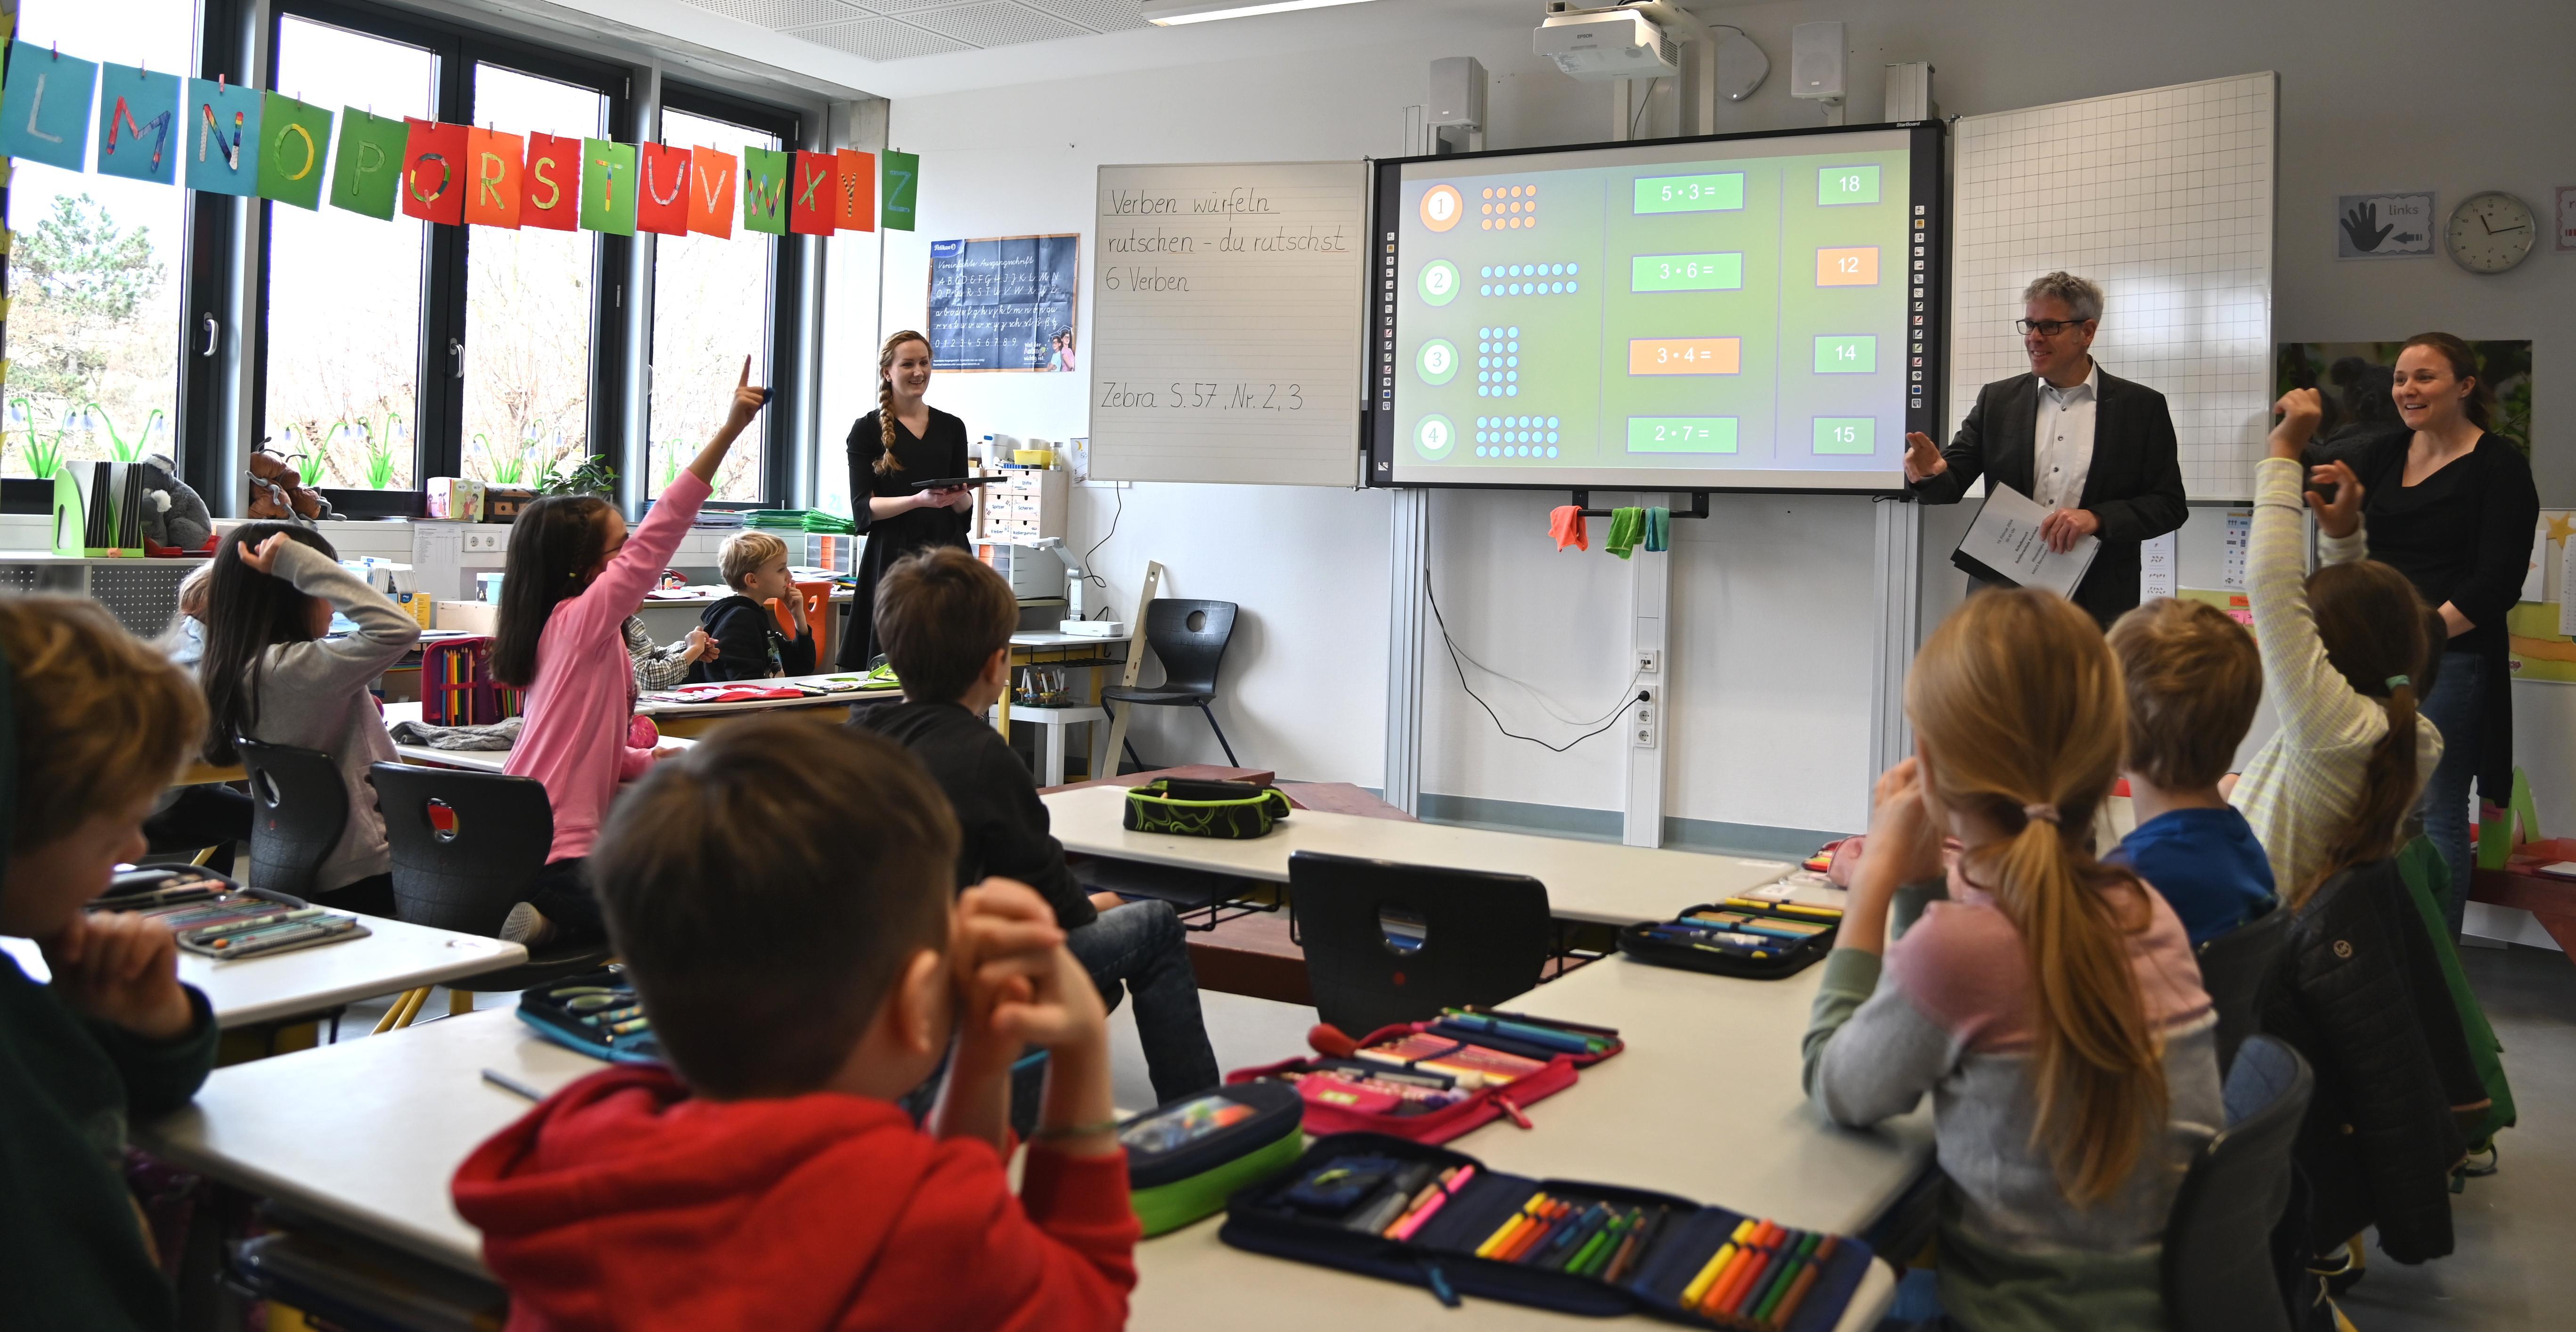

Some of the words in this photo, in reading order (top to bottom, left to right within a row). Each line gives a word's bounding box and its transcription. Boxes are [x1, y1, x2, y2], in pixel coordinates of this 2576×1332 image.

[27, 74, 63, 144] L
[106, 95, 171, 171] M
[199, 104, 243, 170] N
[274, 123, 314, 180] O
[352, 140, 385, 196] P
[410, 152, 450, 208] Q
[480, 152, 505, 210] R
[532, 157, 560, 209] S
[595, 159, 623, 212] T
[648, 155, 686, 205] U
[699, 165, 726, 213] V
[746, 169, 784, 220] W
[797, 161, 826, 212] X
[841, 172, 856, 217] Y
[889, 170, 911, 213] Z
[1839, 175, 1860, 192] 18
[1661, 186, 1672, 201] 5
[1689, 184, 1699, 200] 3
[1112, 189, 1178, 215] Verben
[1194, 187, 1269, 221] würfeln
[1438, 198, 1443, 214] 1
[2389, 204, 2419, 215] links
[1108, 227, 1193, 253] rutschen
[1220, 227, 1243, 252] du
[1254, 225, 1345, 253] rutschst
[1660, 263, 1669, 279] 3
[1687, 262, 1697, 278] 6
[1838, 257, 1858, 273] 12
[1106, 267, 1120, 291] 6
[1129, 267, 1190, 292] Verben
[1434, 273, 1443, 288] 2
[1432, 351, 1442, 367] 3
[1657, 347, 1668, 363] 3
[1684, 347, 1695, 362] 4
[1835, 344, 1856, 360] 14
[1101, 381, 1157, 408] Zebra
[1289, 384, 1303, 409] 3
[1428, 427, 1439, 442] 4
[1655, 425, 1665, 441] 2
[1683, 426, 1693, 441] 7
[1834, 426, 1855, 442] 15
